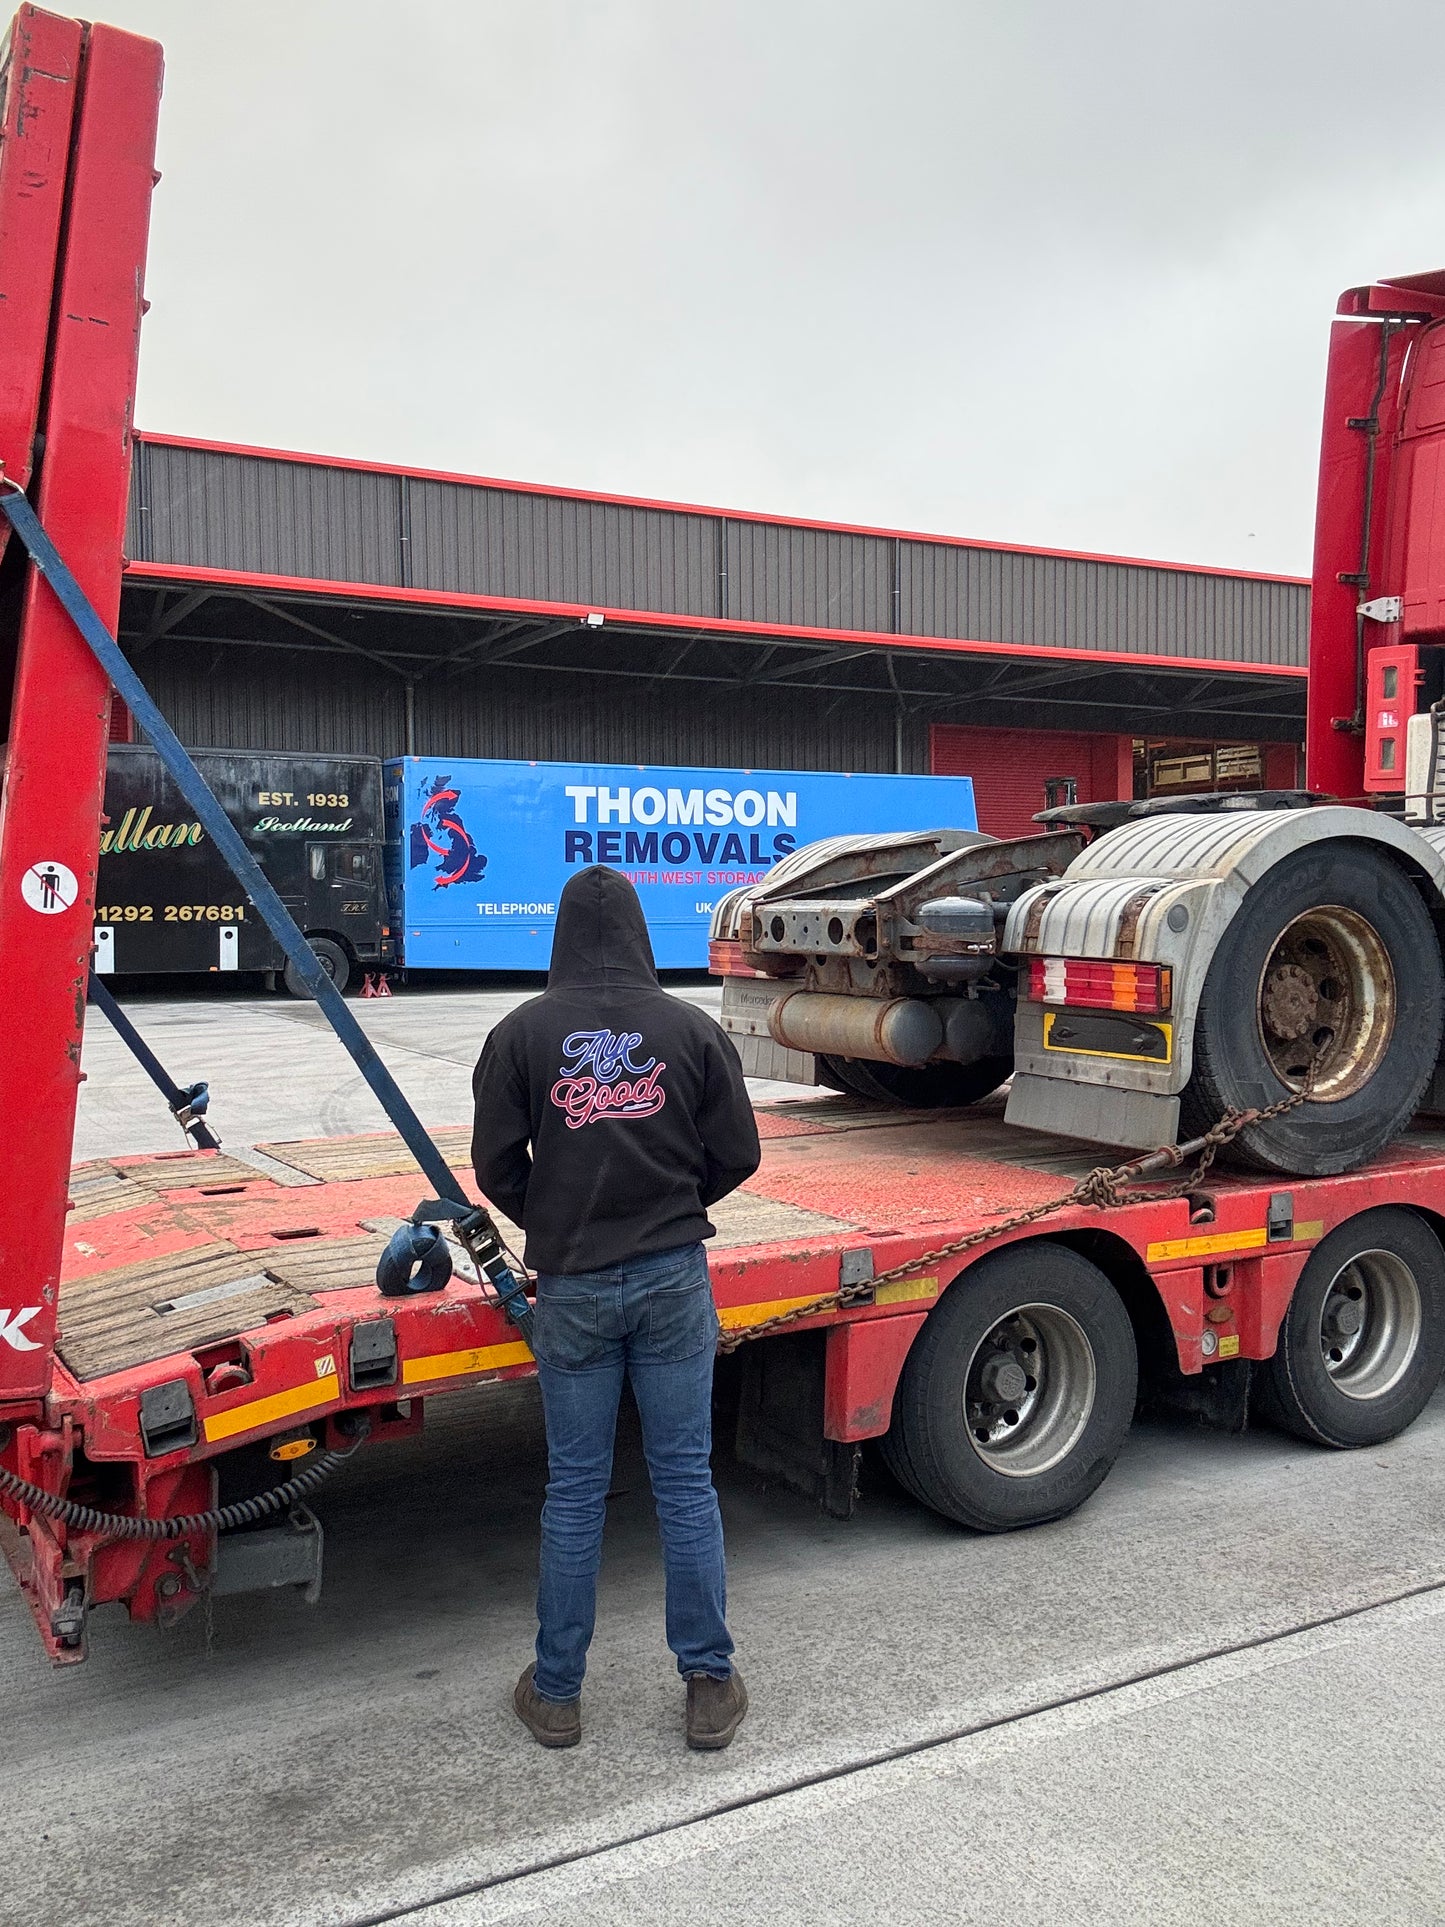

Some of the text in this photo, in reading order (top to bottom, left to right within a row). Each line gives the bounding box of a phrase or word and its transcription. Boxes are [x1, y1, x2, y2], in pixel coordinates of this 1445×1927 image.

[258, 792, 349, 808] EST. 1933
[564, 785, 797, 827] THOMSON
[253, 816, 354, 832] Scotland
[564, 830, 796, 865] REMOVALS
[661, 871, 703, 884] WEST
[93, 905, 244, 921] 1292 267681
[476, 902, 556, 915] TELEPHONE
[559, 1029, 656, 1083] Aye
[551, 1063, 666, 1129] Good
